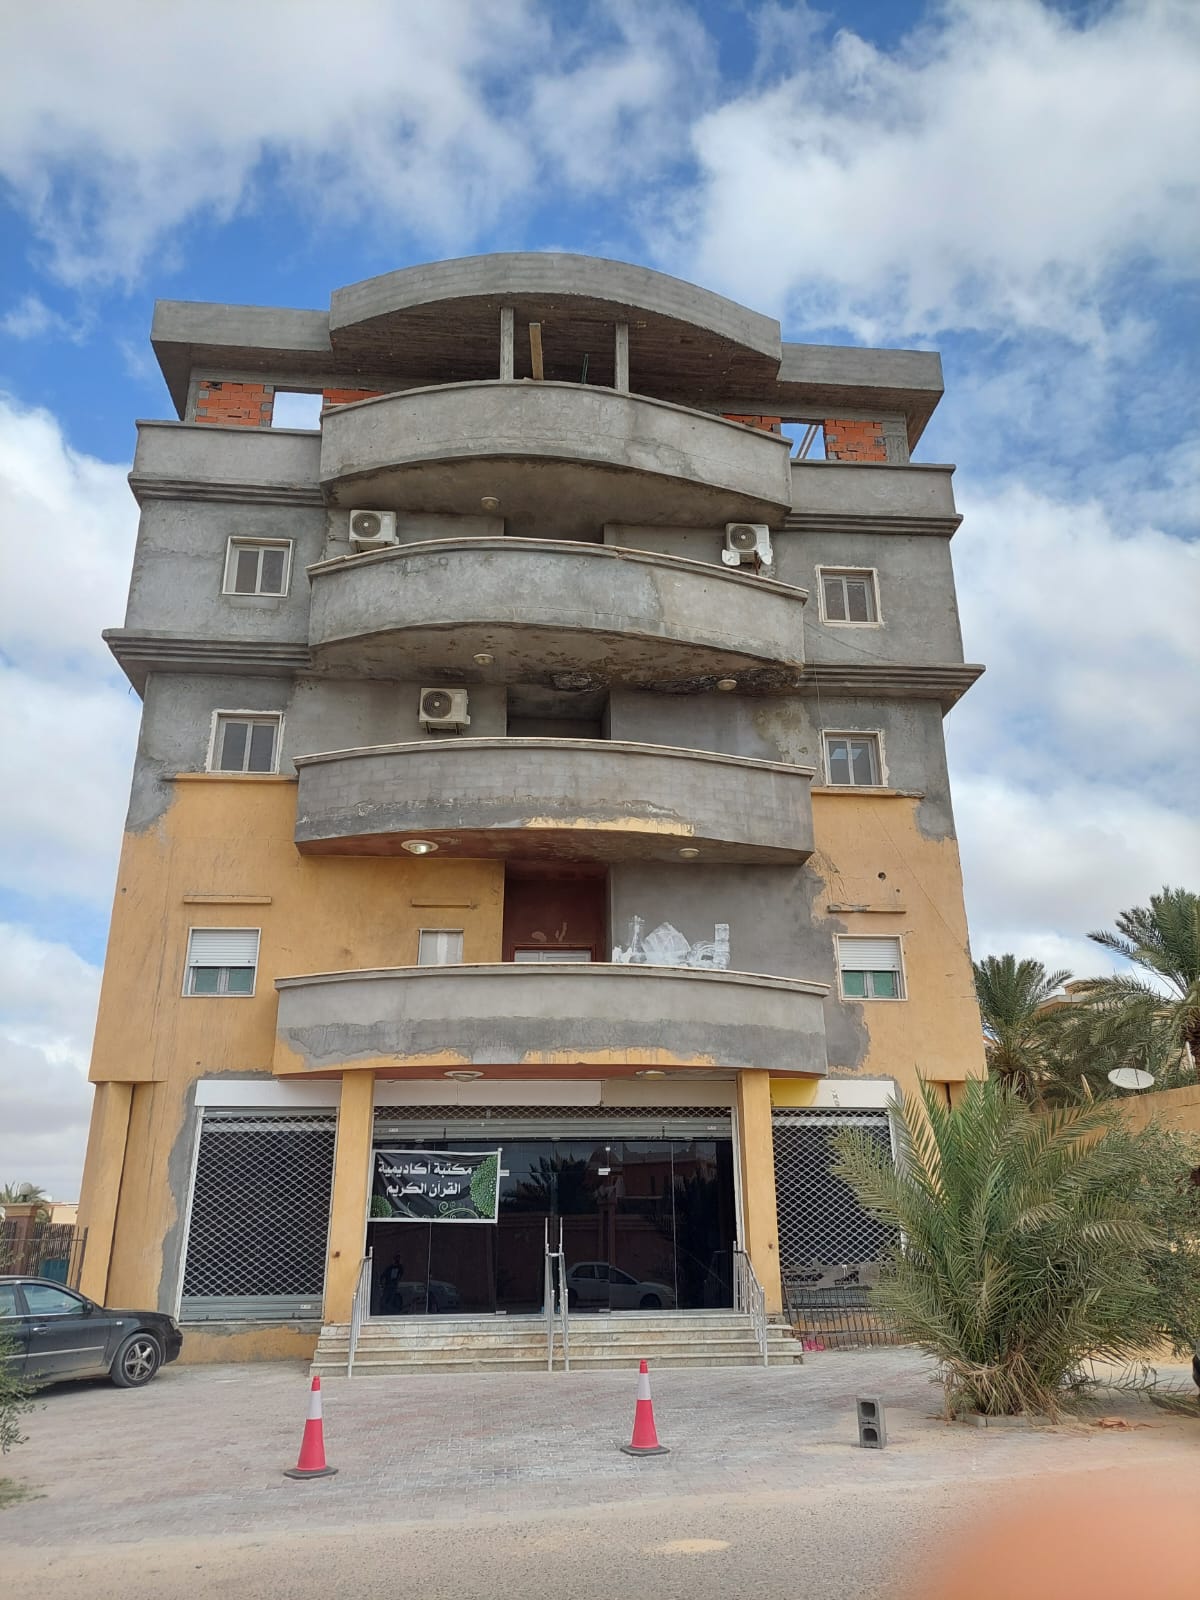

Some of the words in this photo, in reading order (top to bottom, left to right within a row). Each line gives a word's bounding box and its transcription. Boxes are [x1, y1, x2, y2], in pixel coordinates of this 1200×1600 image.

[378, 1160, 431, 1177] أكاديمية
[433, 1162, 472, 1178] مكتبة
[386, 1182, 427, 1197] الكريم
[428, 1181, 461, 1197] القرآن
